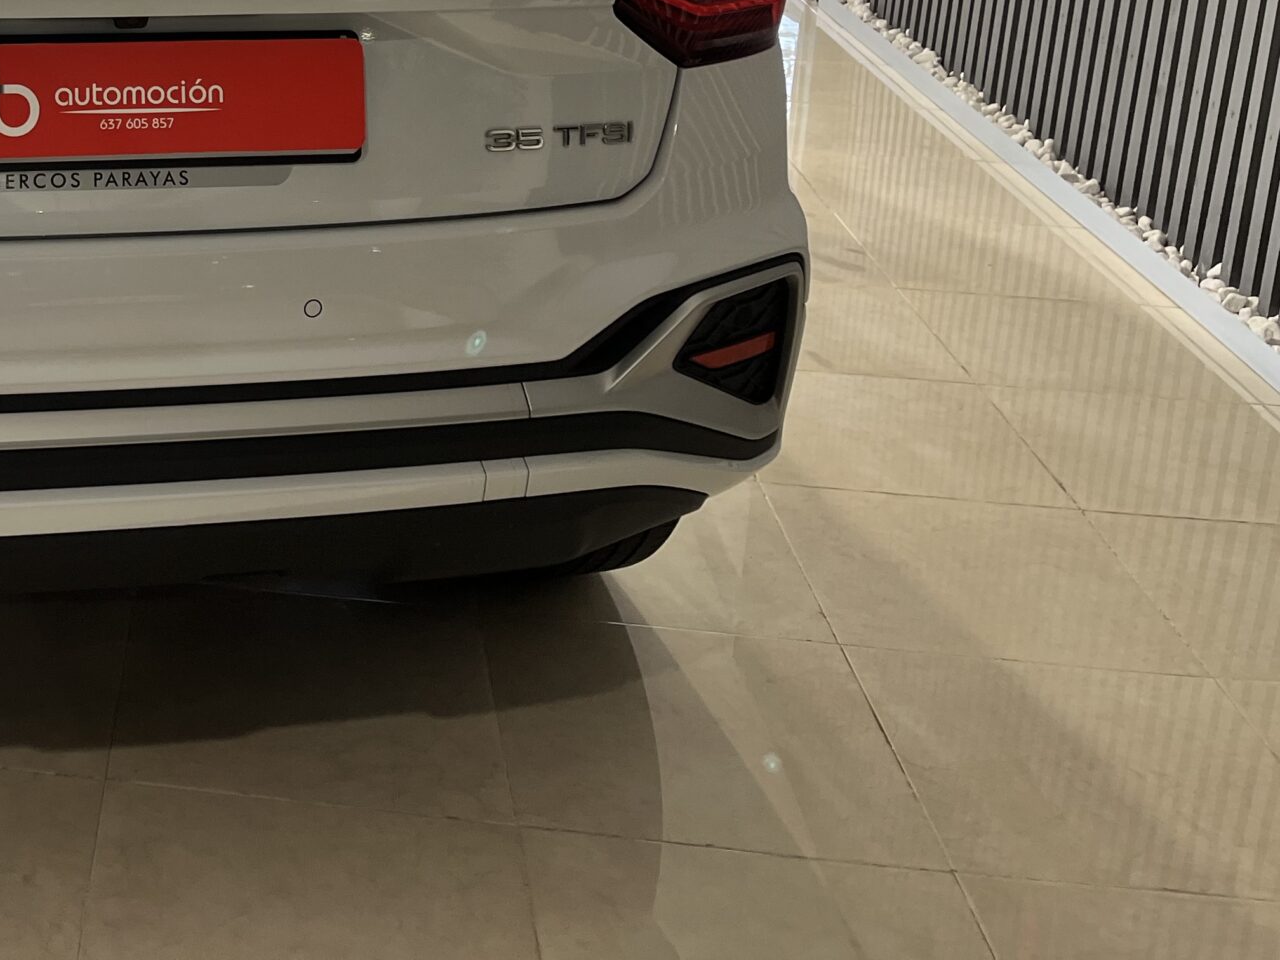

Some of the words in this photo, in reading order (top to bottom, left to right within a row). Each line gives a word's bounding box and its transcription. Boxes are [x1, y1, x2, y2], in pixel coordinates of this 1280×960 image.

[54, 78, 224, 107] automoción
[100, 118, 123, 131] 637
[126, 117, 149, 130] 605
[152, 117, 175, 130] 857
[485, 127, 545, 152] 35
[552, 120, 634, 148] TFSI
[93, 170, 190, 188] PARAYAS
